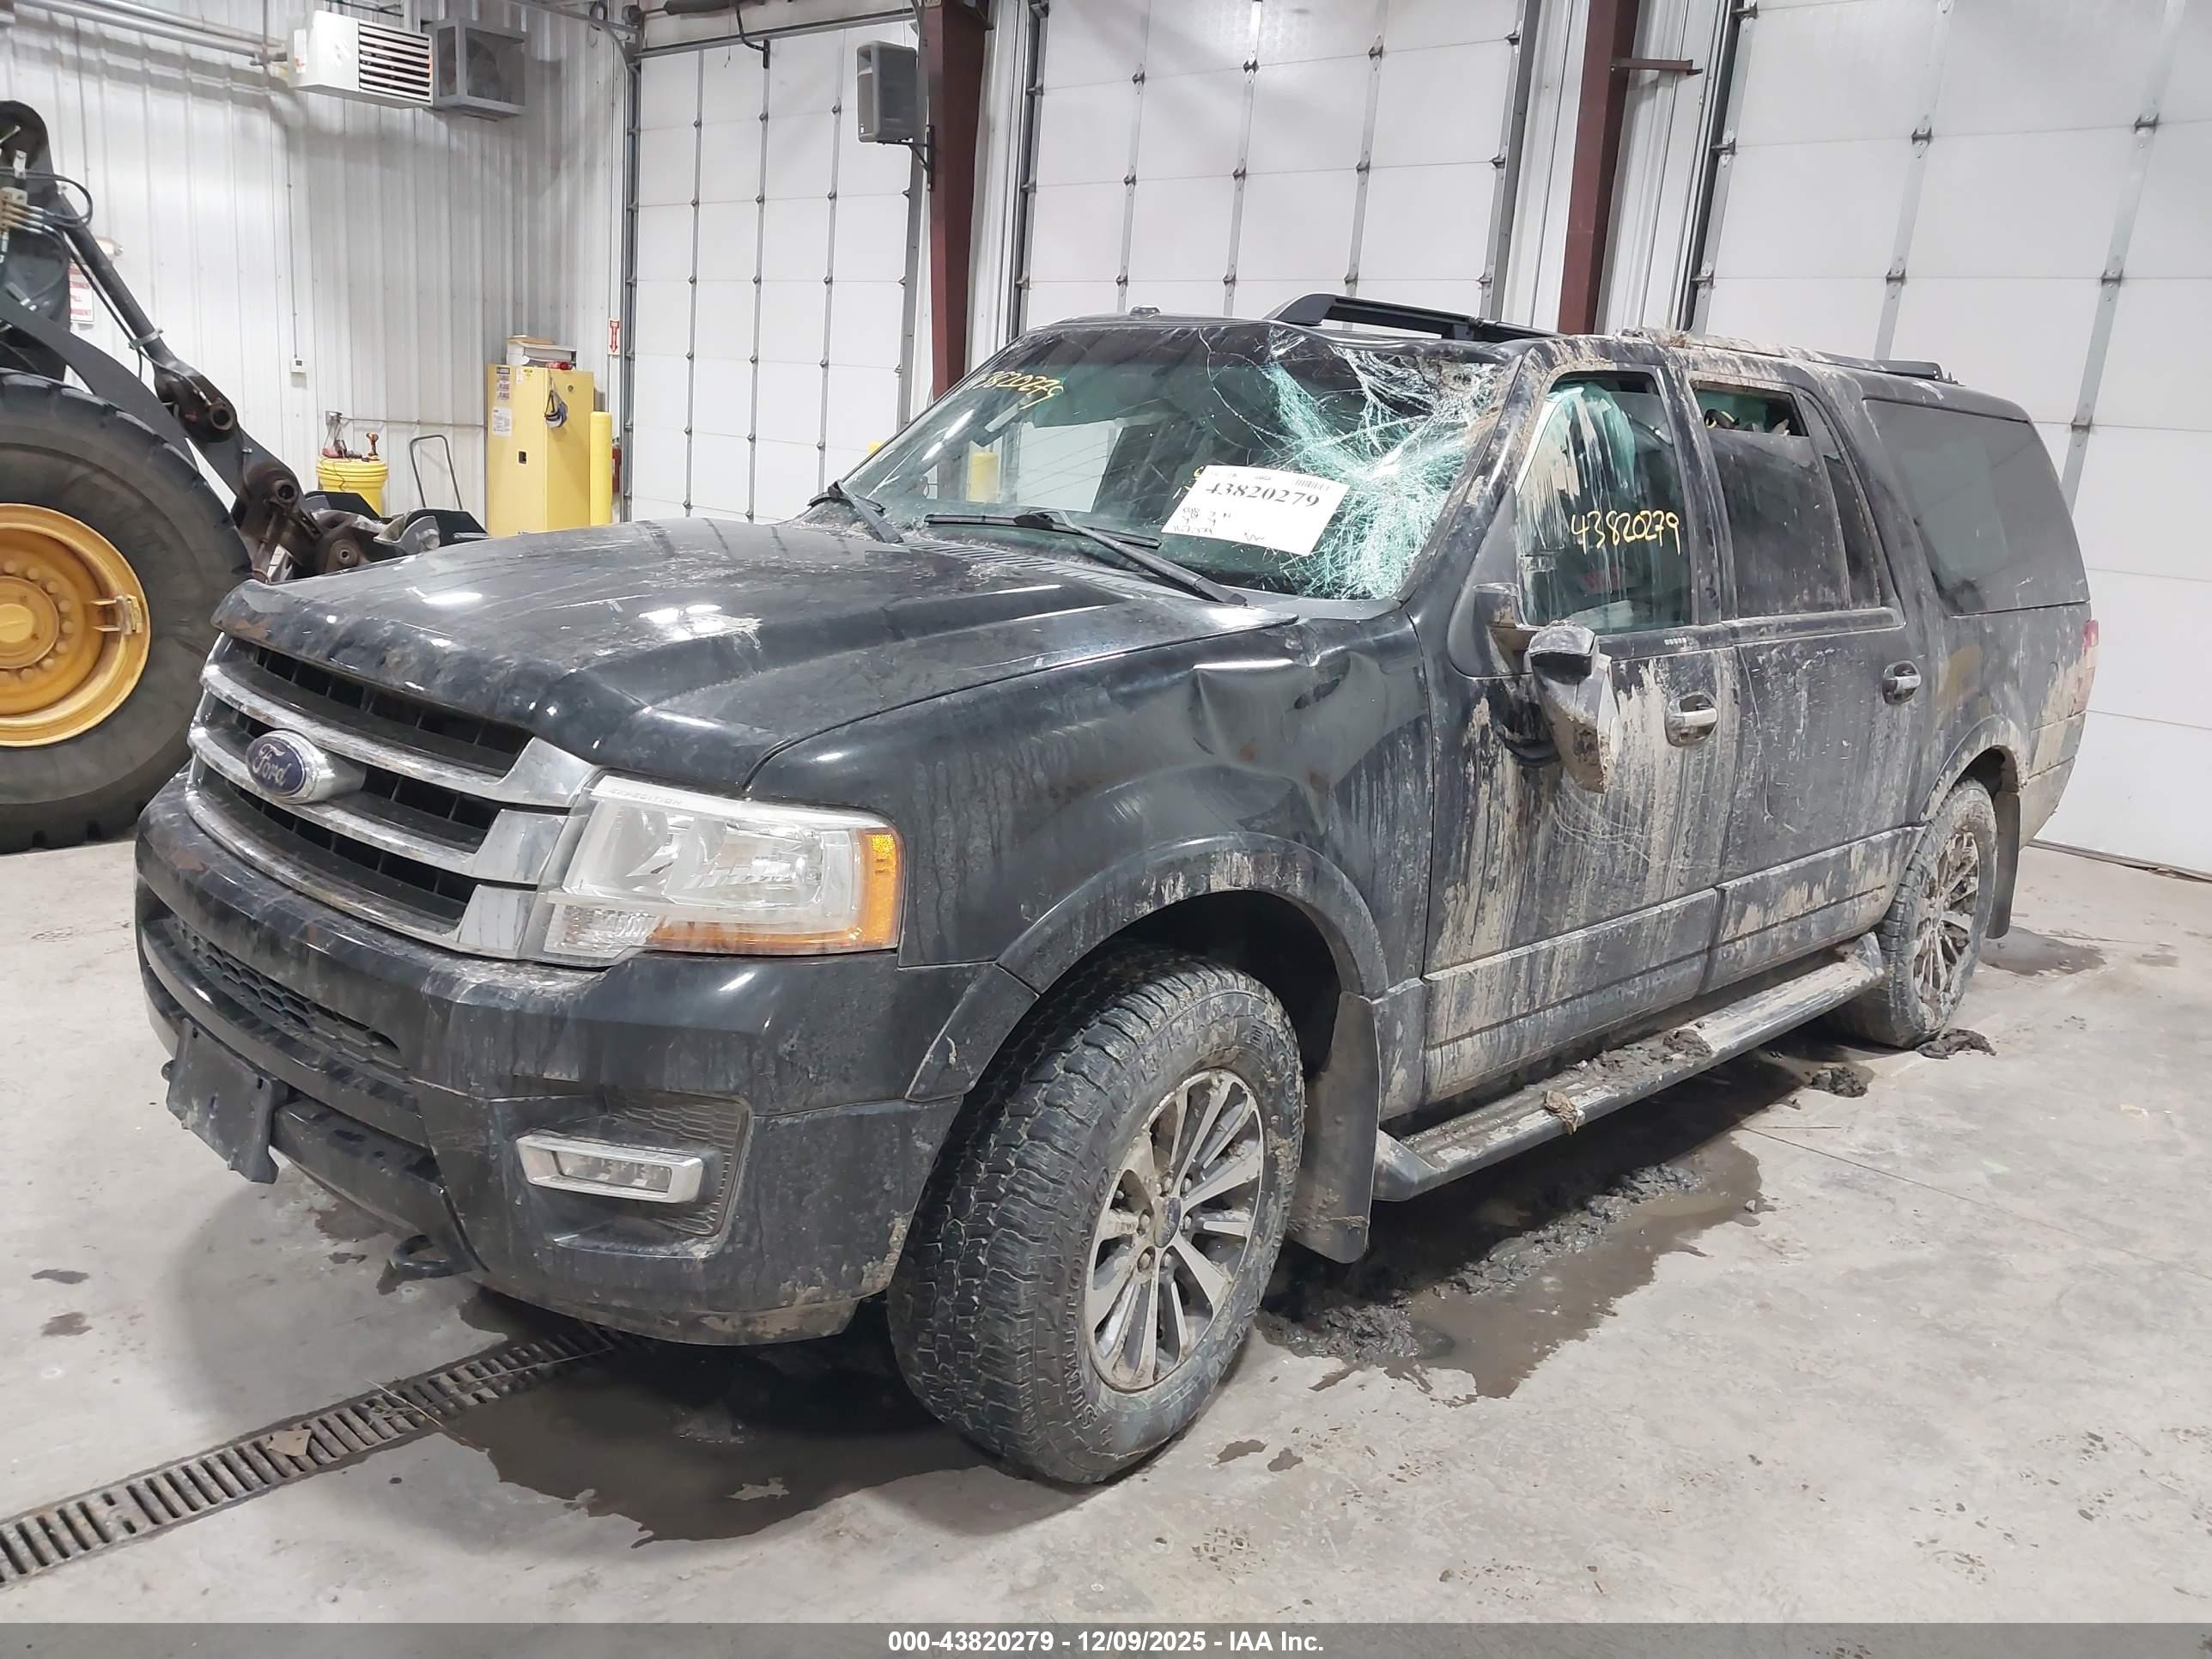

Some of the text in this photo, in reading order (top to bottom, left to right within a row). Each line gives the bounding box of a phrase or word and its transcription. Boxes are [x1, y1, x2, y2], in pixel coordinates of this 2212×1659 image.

[1205, 482, 1320, 507] 43820279
[1571, 510, 1680, 556] 43820279
[252, 743, 293, 787] Ford
